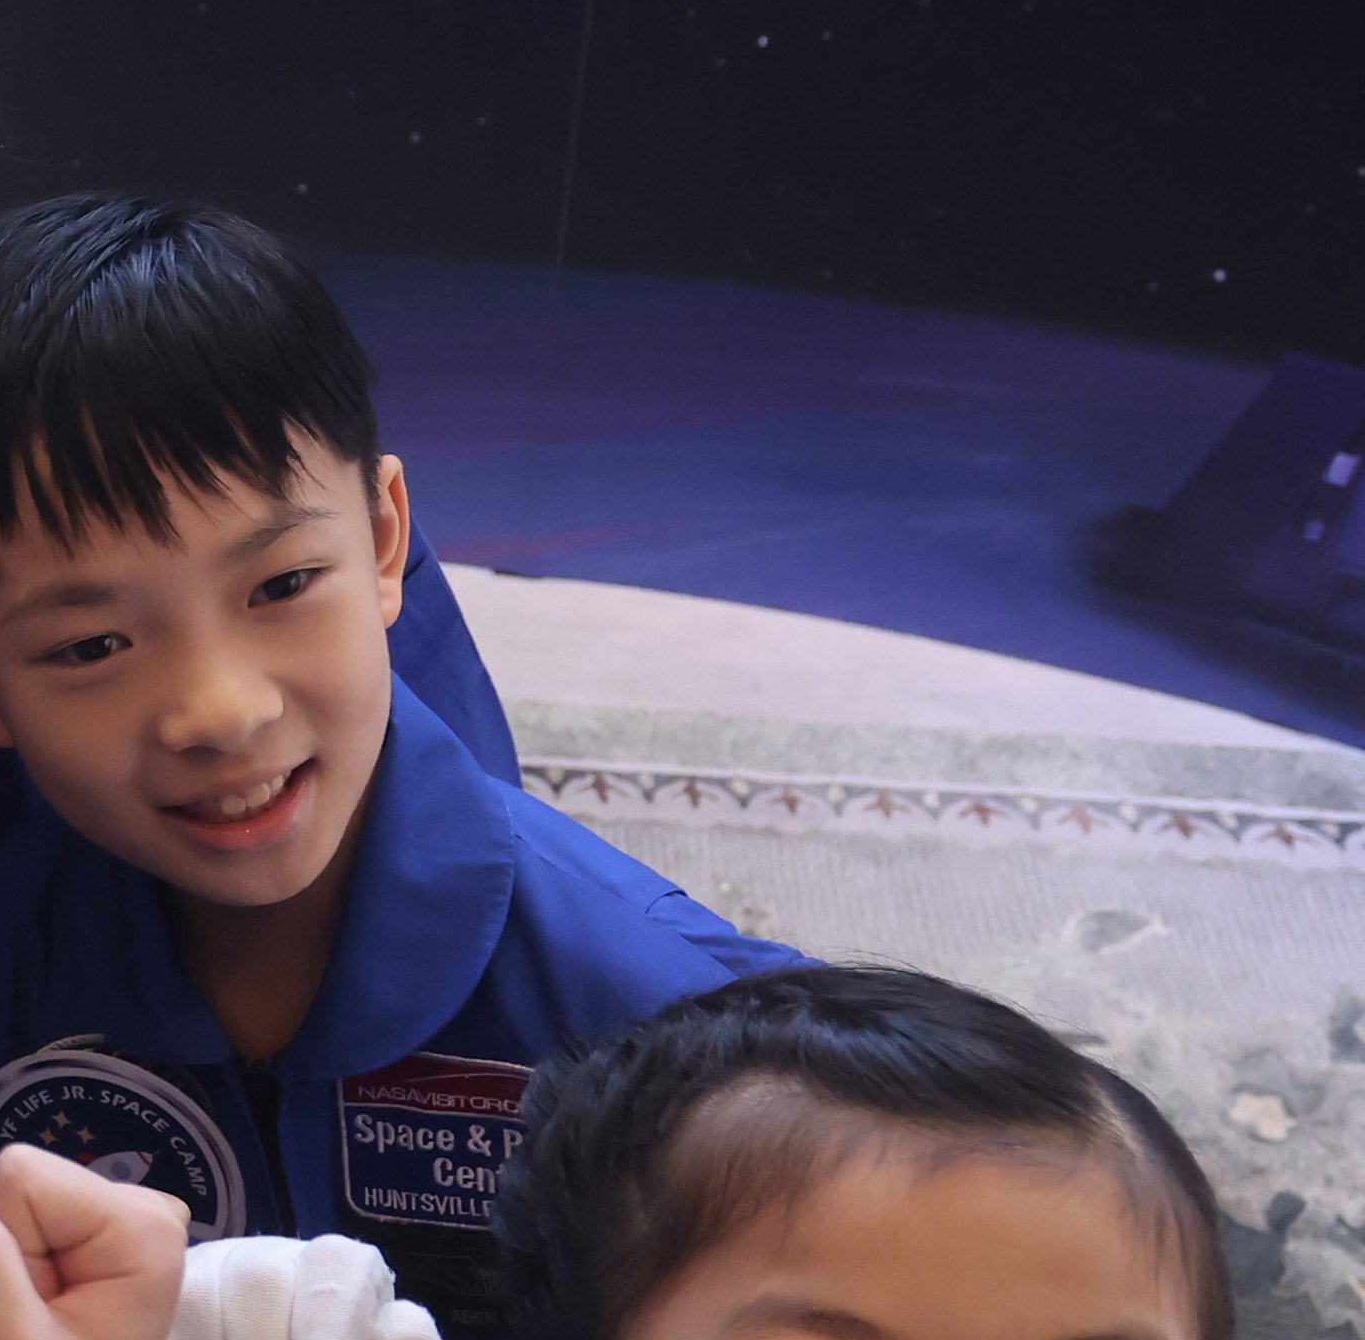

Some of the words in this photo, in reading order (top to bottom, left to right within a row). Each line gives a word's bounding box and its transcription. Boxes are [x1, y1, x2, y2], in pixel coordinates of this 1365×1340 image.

[0, 1118, 18, 1141] YF
[14, 1089, 54, 1120] LIFE
[61, 1085, 93, 1100] JR.
[99, 1090, 170, 1133] SPACE
[170, 1136, 207, 1196] CAMP
[354, 1114, 455, 1153] Space
[467, 1124, 492, 1157] &
[432, 1157, 506, 1193] Cen
